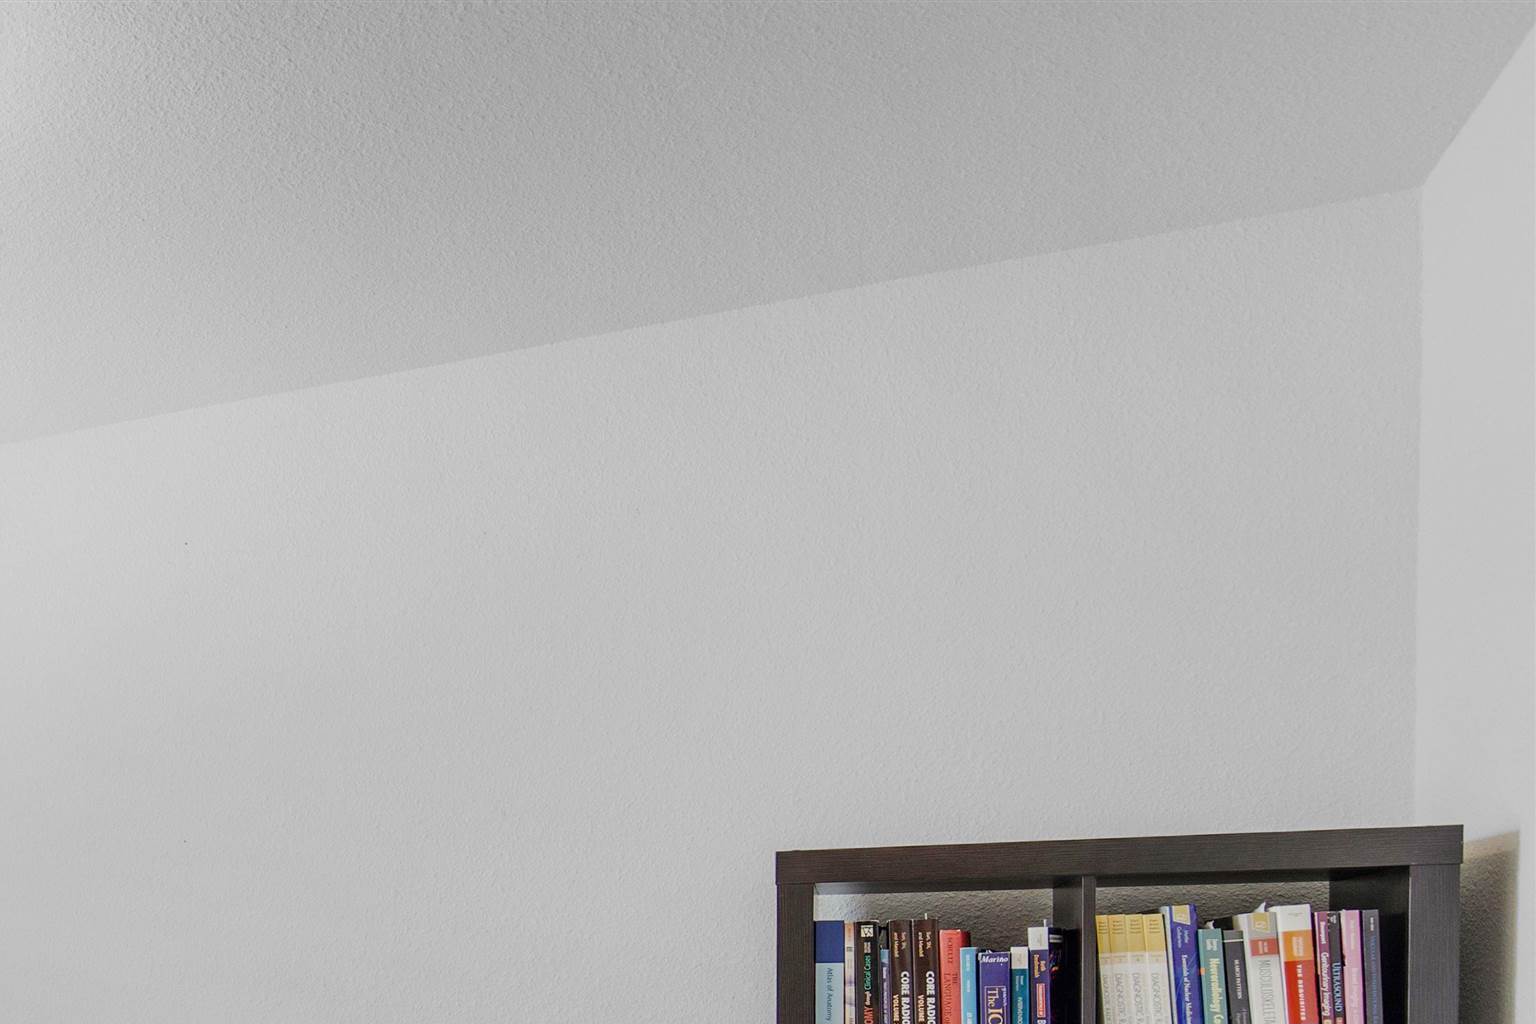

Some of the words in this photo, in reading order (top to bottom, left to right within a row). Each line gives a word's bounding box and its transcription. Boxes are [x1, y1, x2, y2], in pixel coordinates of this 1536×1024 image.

[901, 971, 910, 996] CORE
[926, 971, 935, 996] CORE
[825, 993, 834, 1021] Anatomy
[988, 988, 1000, 1007] The
